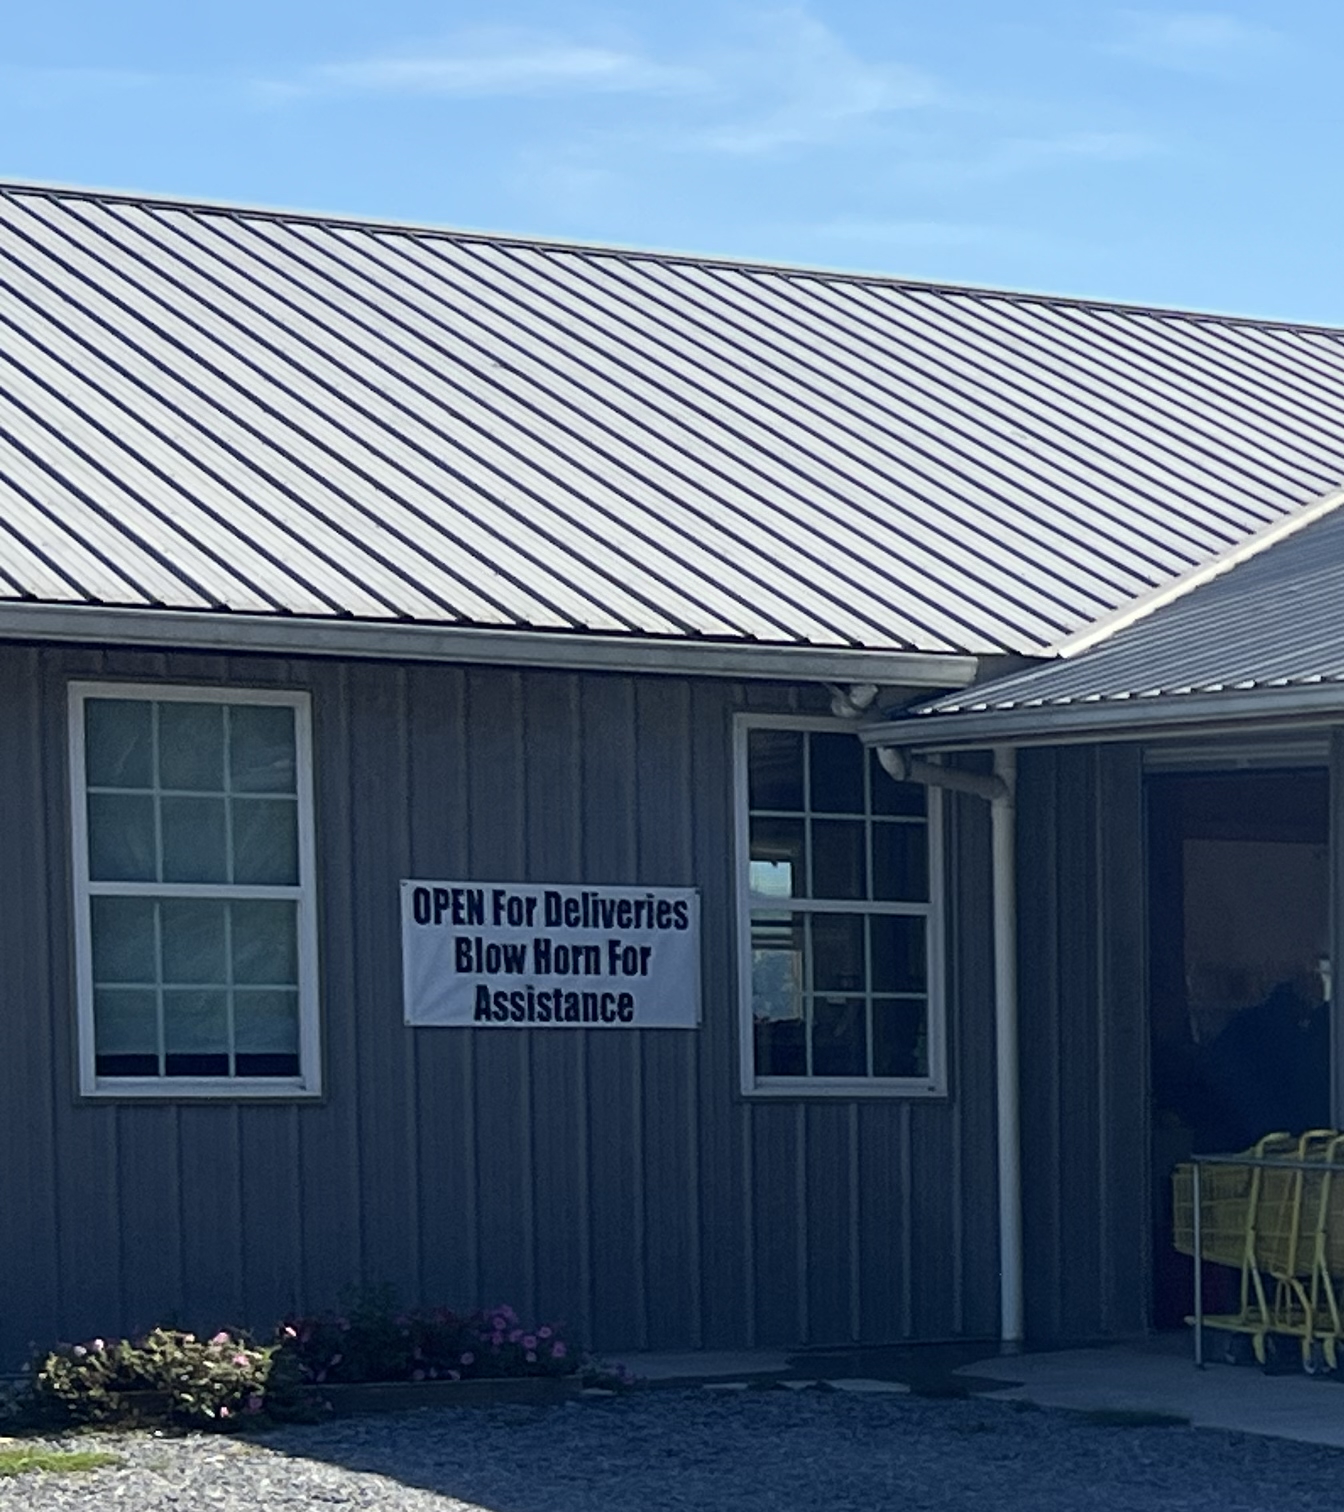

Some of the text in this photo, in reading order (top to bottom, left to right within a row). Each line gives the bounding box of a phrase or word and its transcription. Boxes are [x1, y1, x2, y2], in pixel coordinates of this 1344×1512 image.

[412, 887, 690, 931] OPEN For Deliveries
[455, 936, 652, 976] Blow Horn For
[474, 984, 634, 1022] Assistance
